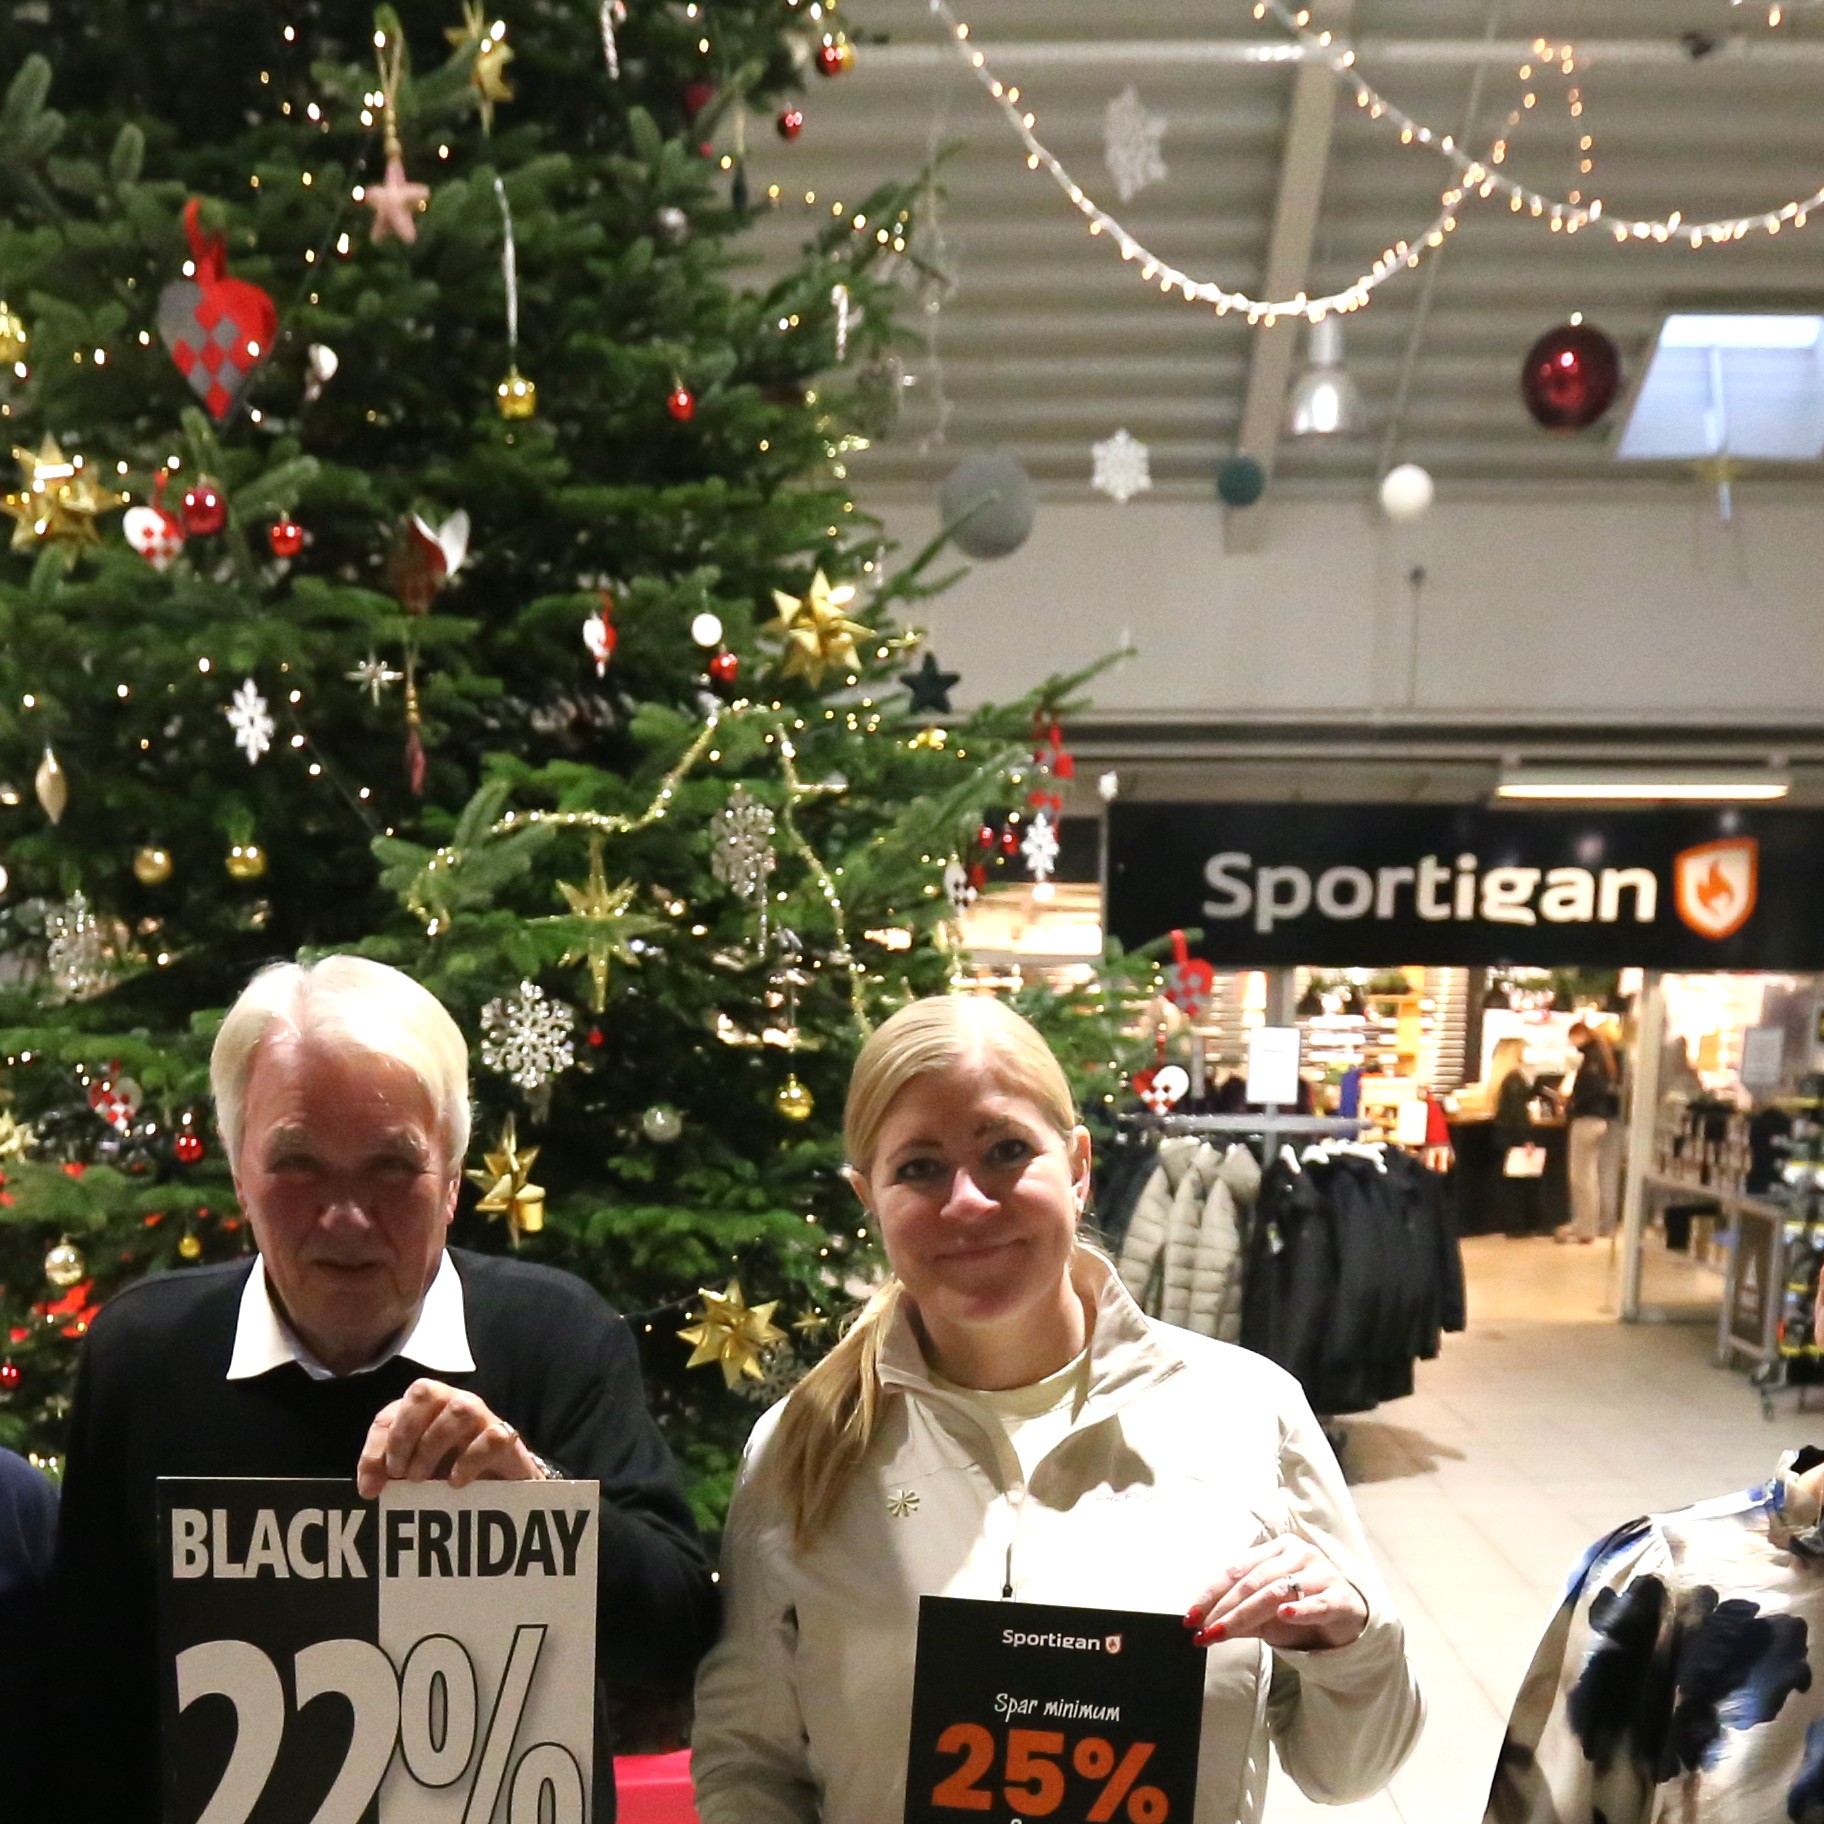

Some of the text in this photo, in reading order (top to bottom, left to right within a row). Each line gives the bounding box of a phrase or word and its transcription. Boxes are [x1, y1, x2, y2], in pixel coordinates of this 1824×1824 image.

[1202, 852, 1657, 933] Sportigan
[171, 1507, 591, 1579] BLACK FRIDAY
[1002, 1628, 1101, 1653] Sportigan
[993, 1692, 1121, 1723] Spar minimum
